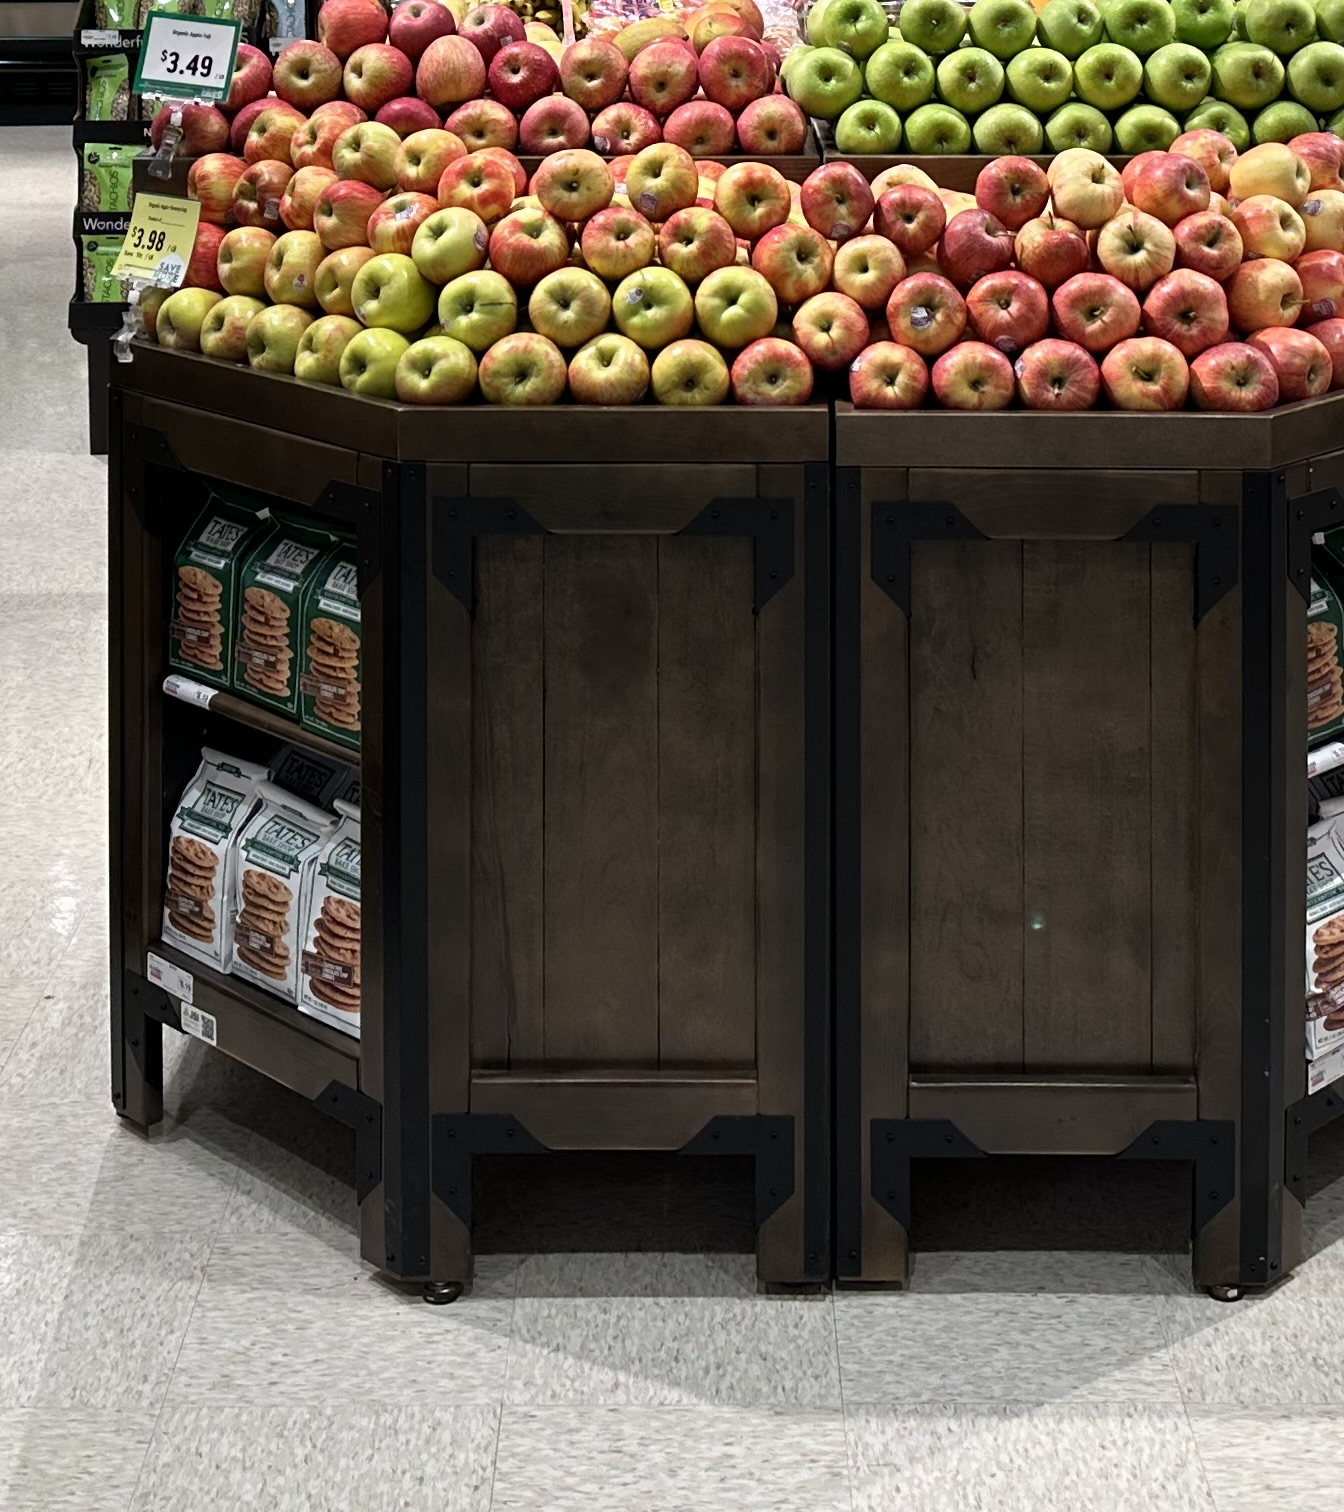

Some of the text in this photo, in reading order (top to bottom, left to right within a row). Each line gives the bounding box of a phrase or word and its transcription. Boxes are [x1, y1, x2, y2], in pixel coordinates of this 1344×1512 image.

[161, 49, 213, 78] $3.49
[83, 217, 131, 231] Wonde
[131, 226, 166, 252] $3.98
[160, 262, 181, 274] SAVE
[331, 564, 357, 585] TAT
[202, 788, 240, 814] TATE'S
[264, 820, 311, 850] TATE'S
